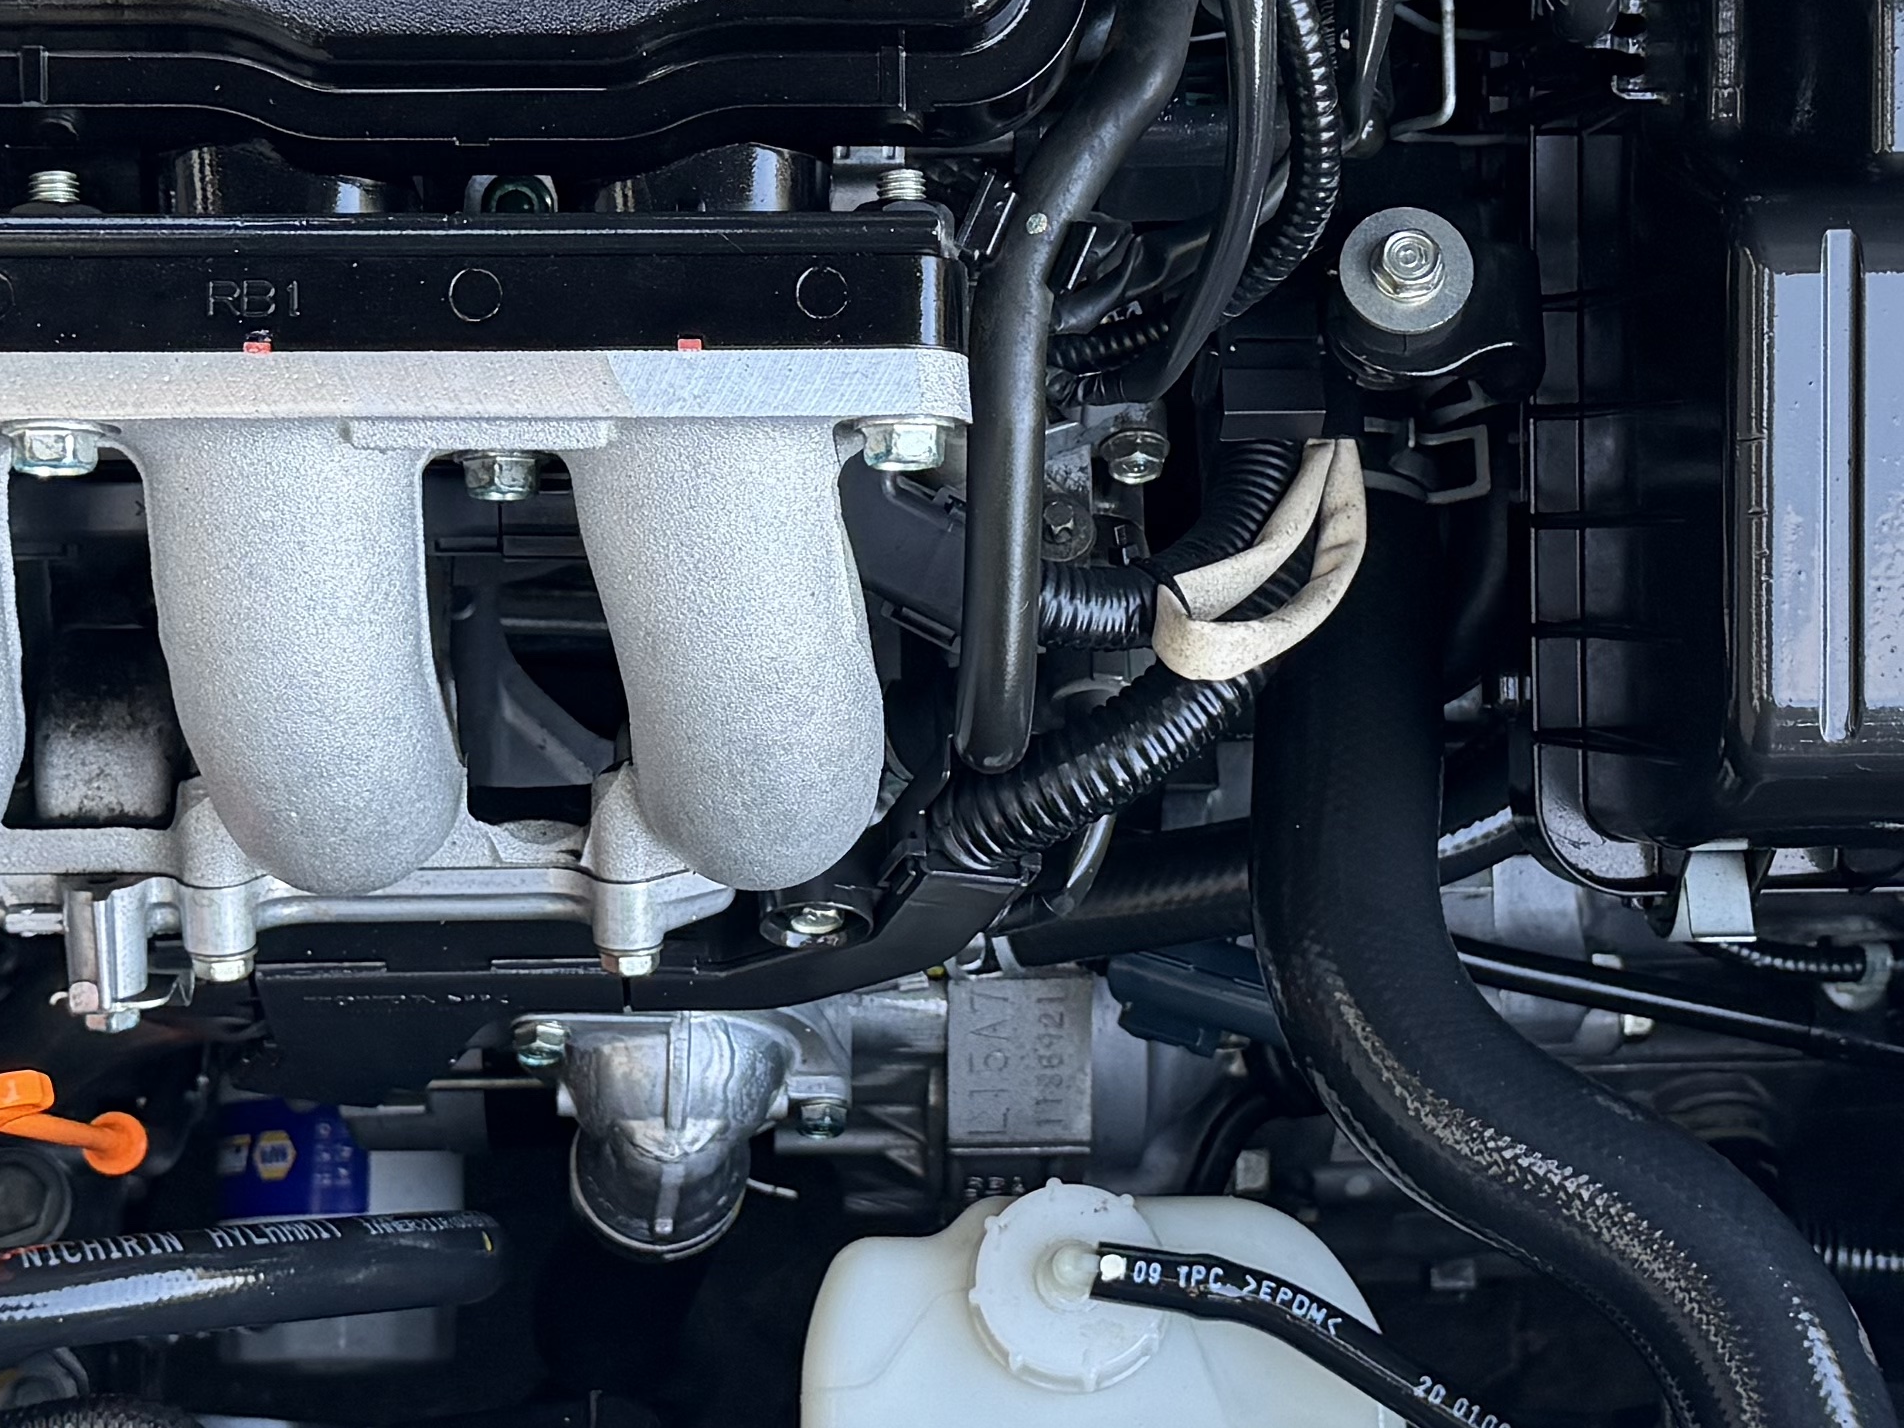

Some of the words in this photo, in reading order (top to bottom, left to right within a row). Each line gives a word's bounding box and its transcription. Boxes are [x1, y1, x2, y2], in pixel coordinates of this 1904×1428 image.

[207, 281, 302, 318] RB1
[967, 987, 1010, 1134] L15A7
[20, 1231, 185, 1269] NICHIRIN
[1177, 1264, 1224, 1291] TPC
[1239, 1274, 1344, 1337] >EPDM<
